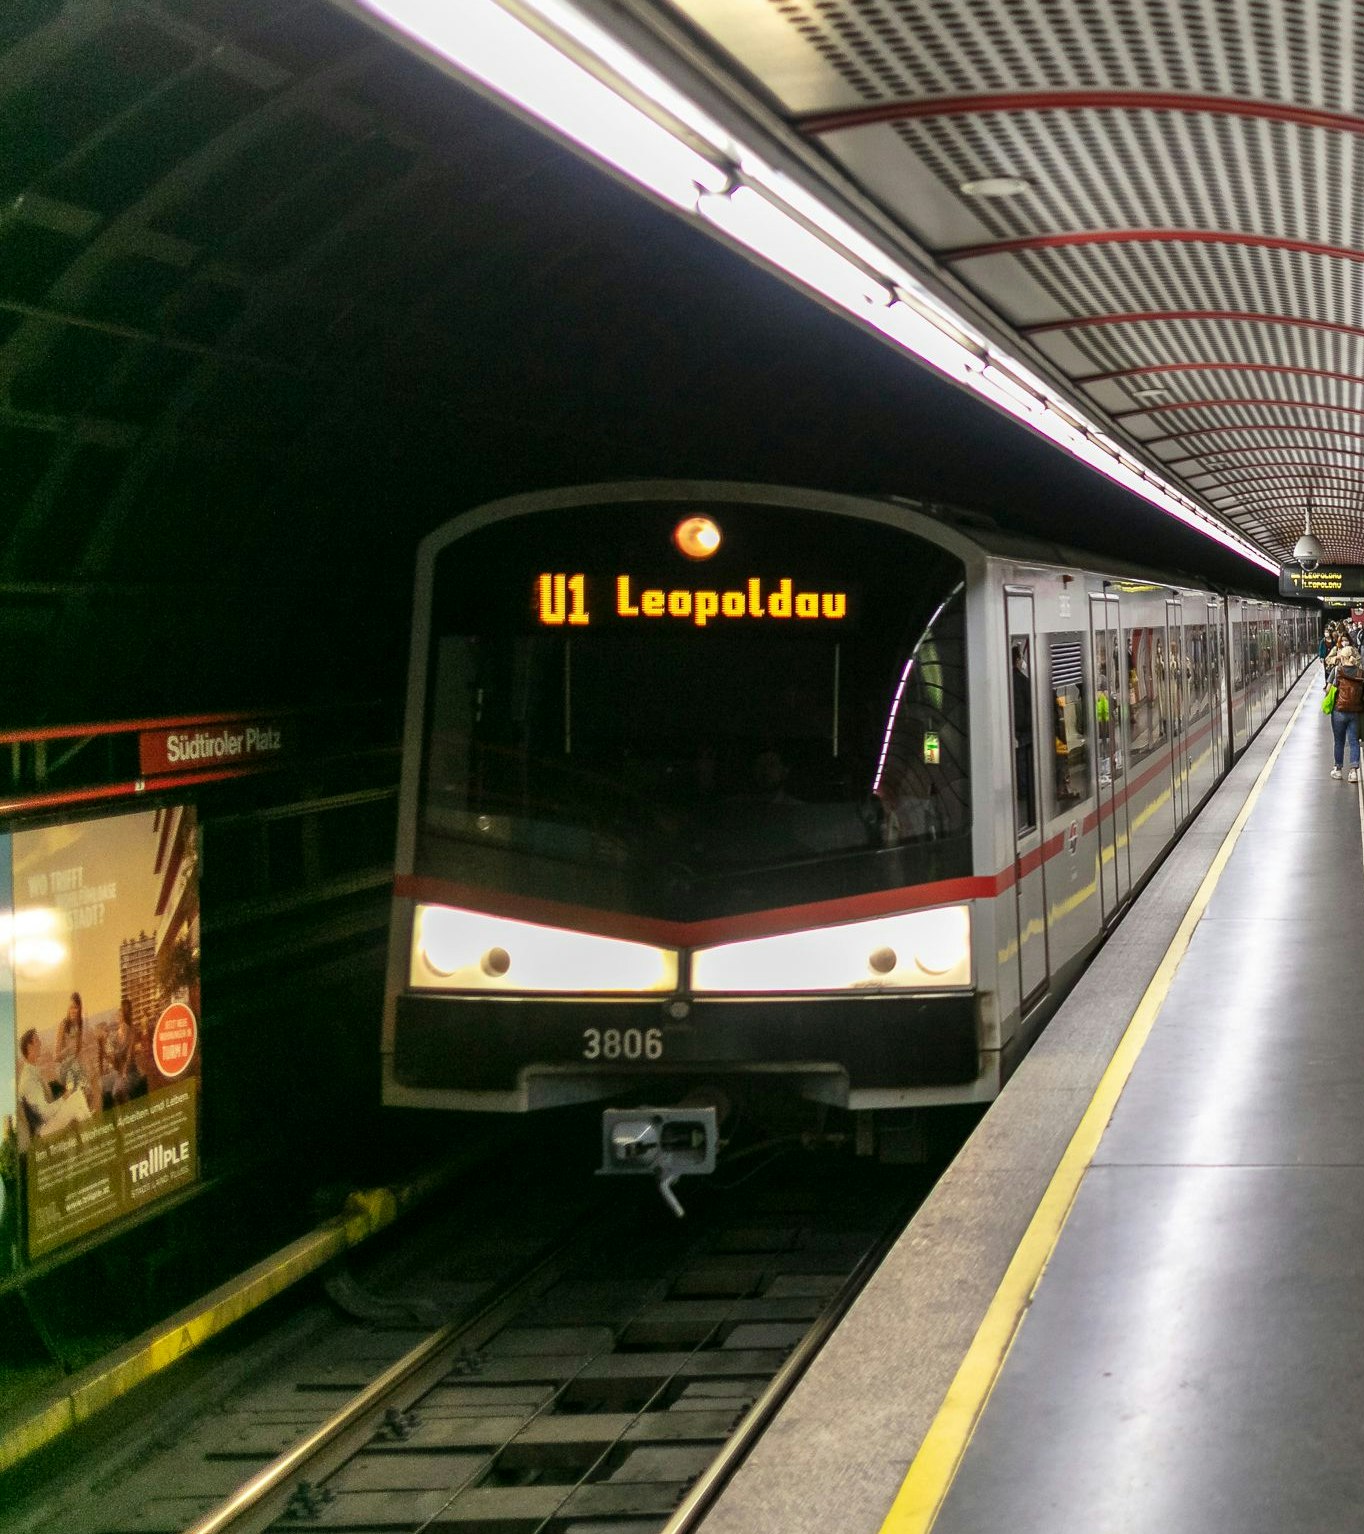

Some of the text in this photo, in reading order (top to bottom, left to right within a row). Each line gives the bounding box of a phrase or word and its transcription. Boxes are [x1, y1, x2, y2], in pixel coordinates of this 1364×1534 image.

[538, 573, 847, 626] U1 Leopoldau
[166, 727, 281, 762] Südtiroler Platz
[582, 1028, 663, 1059] 3806
